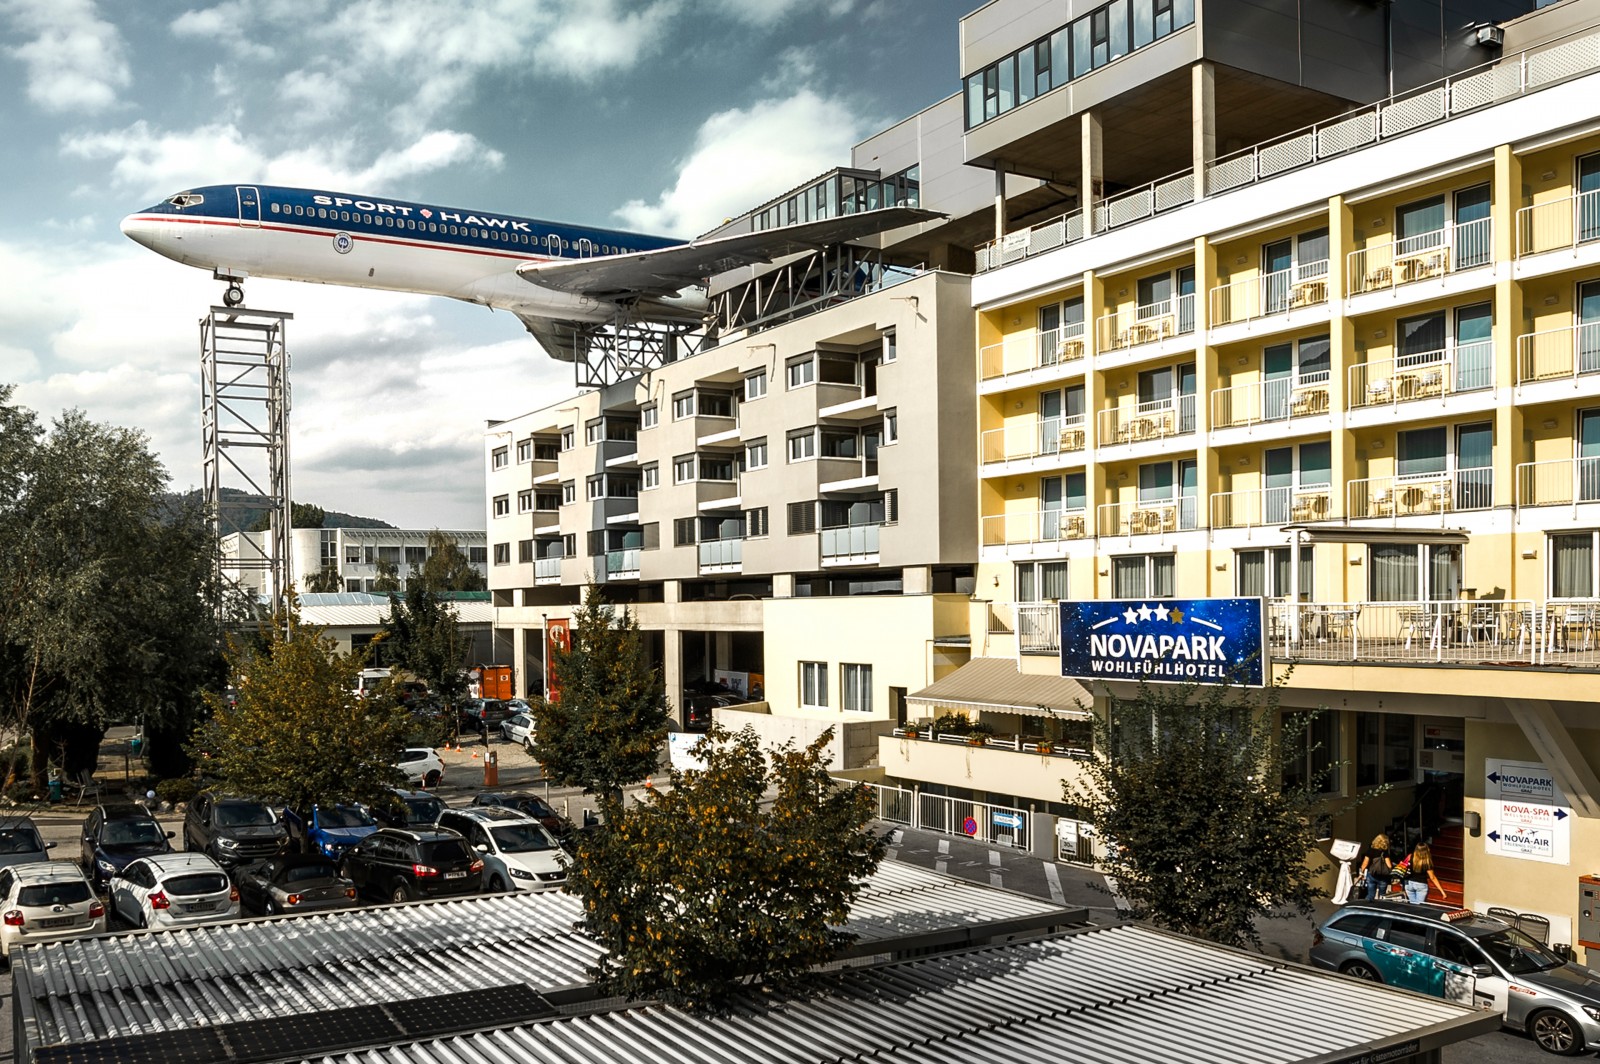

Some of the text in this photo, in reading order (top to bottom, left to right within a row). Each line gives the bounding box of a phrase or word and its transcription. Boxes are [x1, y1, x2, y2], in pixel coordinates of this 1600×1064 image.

[313, 195, 532, 232] SPORT HAWK
[1090, 634, 1226, 661] NOVAPARK
[1091, 660, 1226, 678] WOHLFÜHLHOTEL
[1502, 775, 1552, 787] NOVAPARK
[1504, 805, 1550, 816] NOVA-SPA
[1504, 834, 1549, 847] NOVA-AIR
